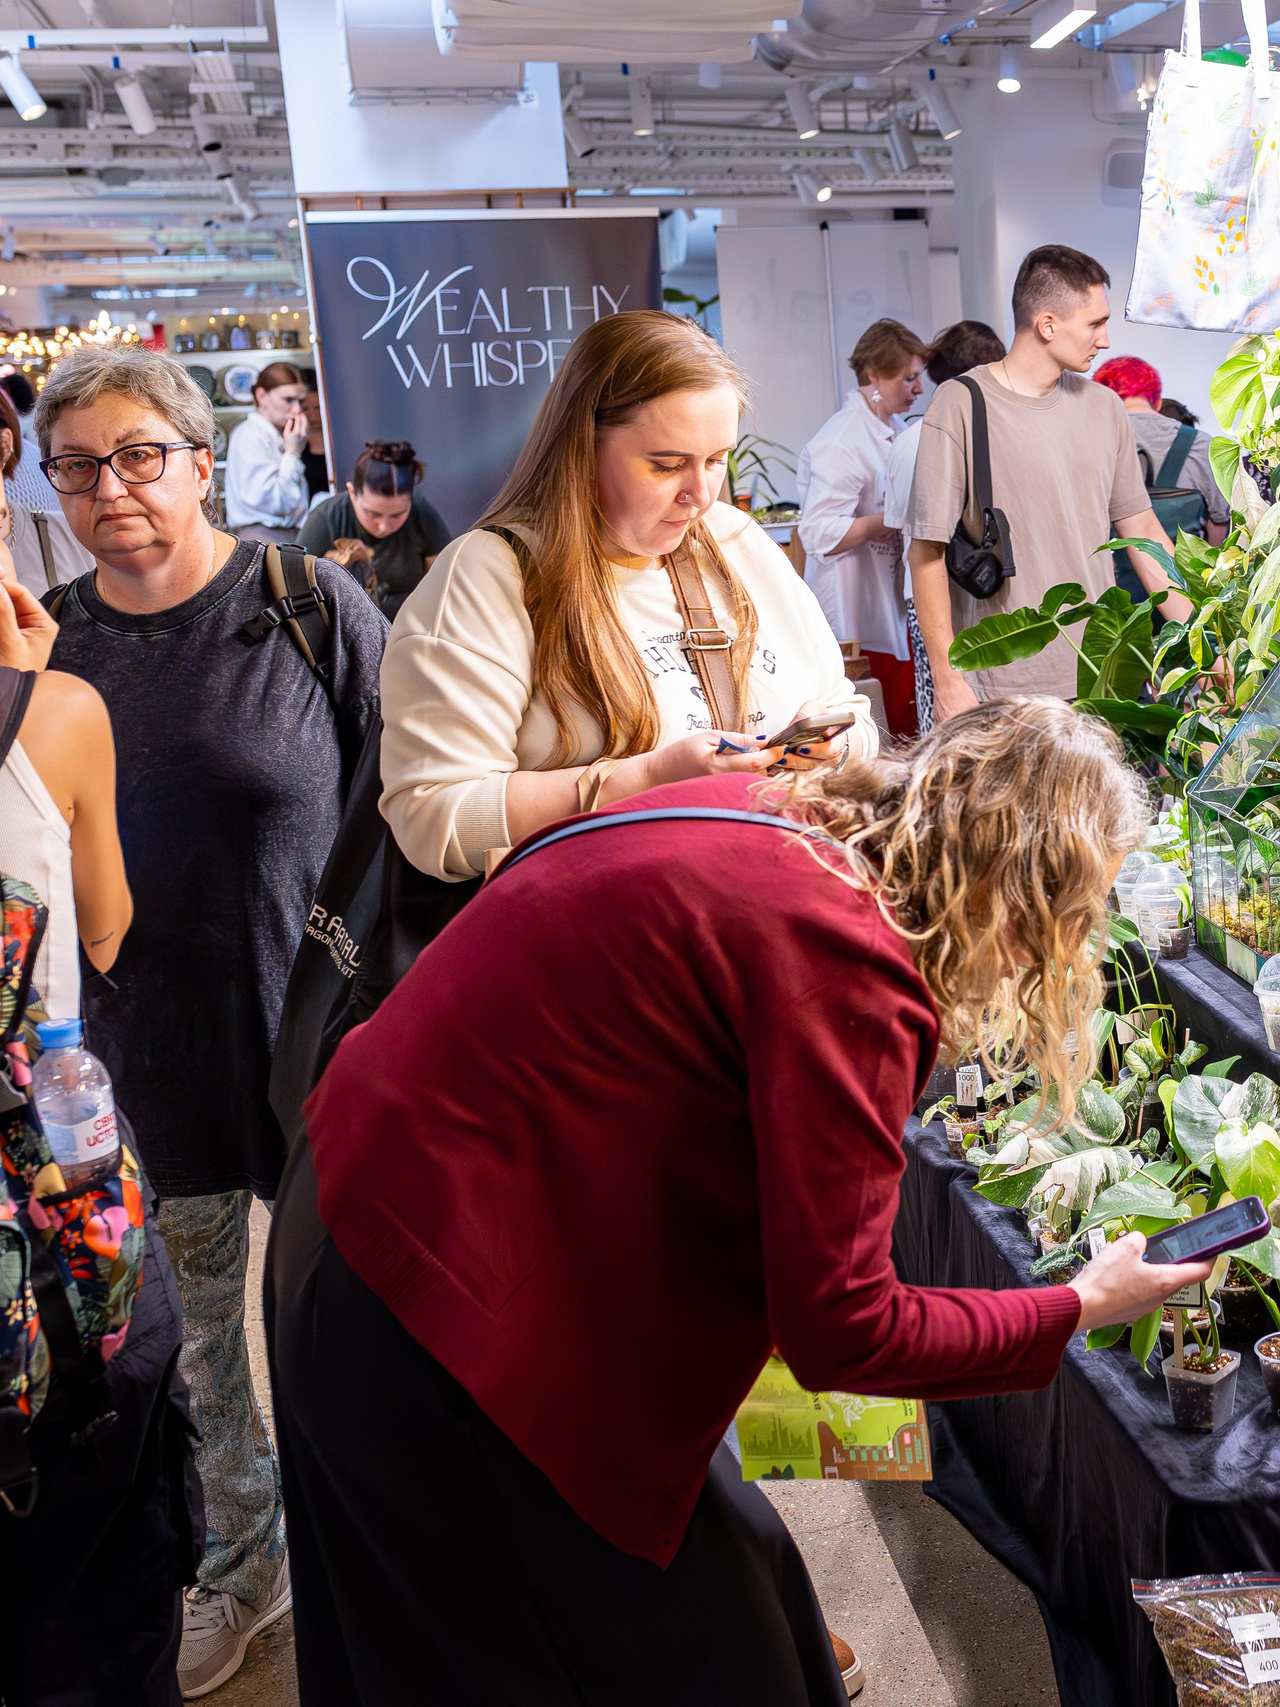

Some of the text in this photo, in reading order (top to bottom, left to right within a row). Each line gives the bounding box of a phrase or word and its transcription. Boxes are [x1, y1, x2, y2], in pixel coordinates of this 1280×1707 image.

[346, 256, 630, 341] WEALTHY
[386, 338, 575, 389] WHISPE
[958, 1074, 975, 1082] 1000
[1259, 1659, 1279, 1672] 400
